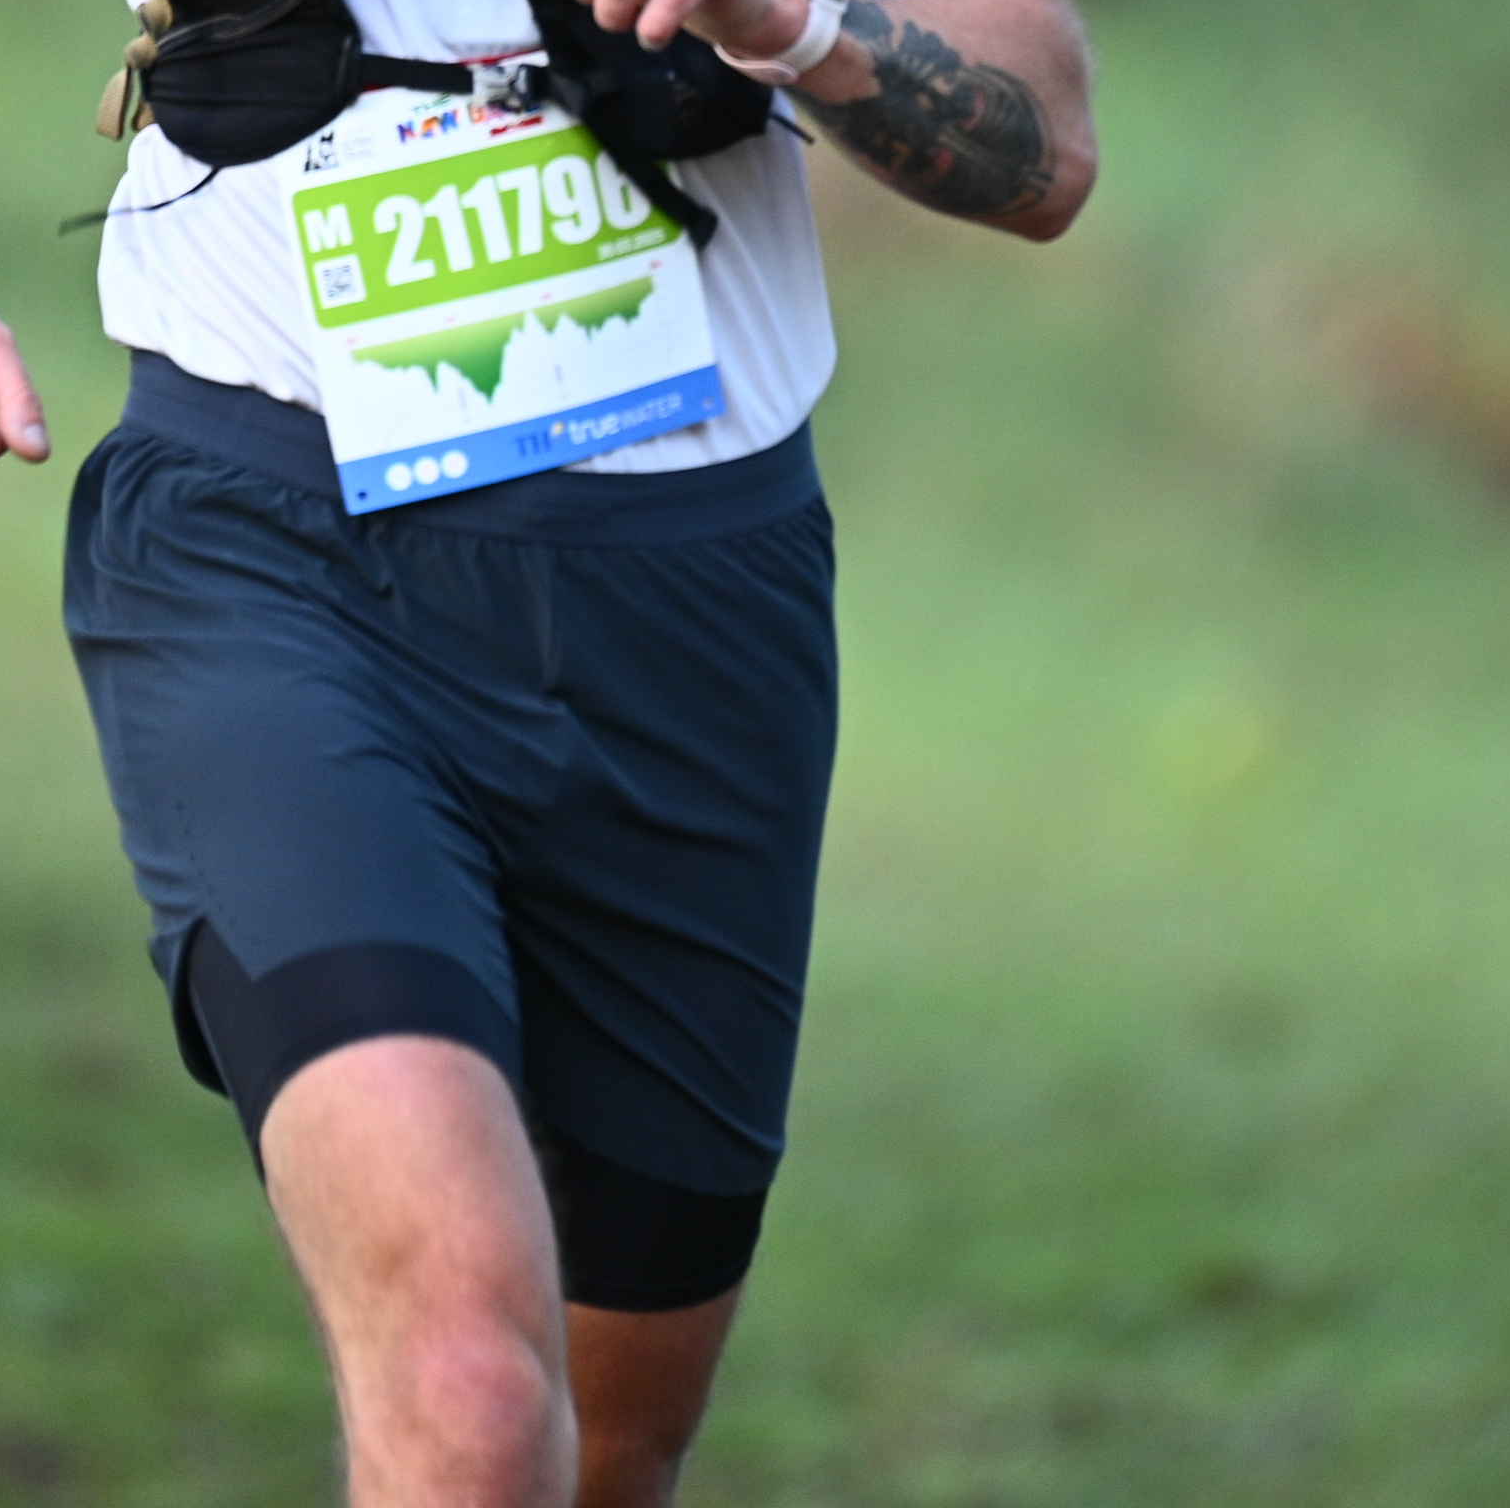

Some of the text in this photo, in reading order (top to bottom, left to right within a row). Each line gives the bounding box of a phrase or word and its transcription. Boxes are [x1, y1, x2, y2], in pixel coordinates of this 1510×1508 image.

[397, 107, 459, 143] NEW
[303, 204, 353, 253] M
[373, 153, 652, 287] 211796
